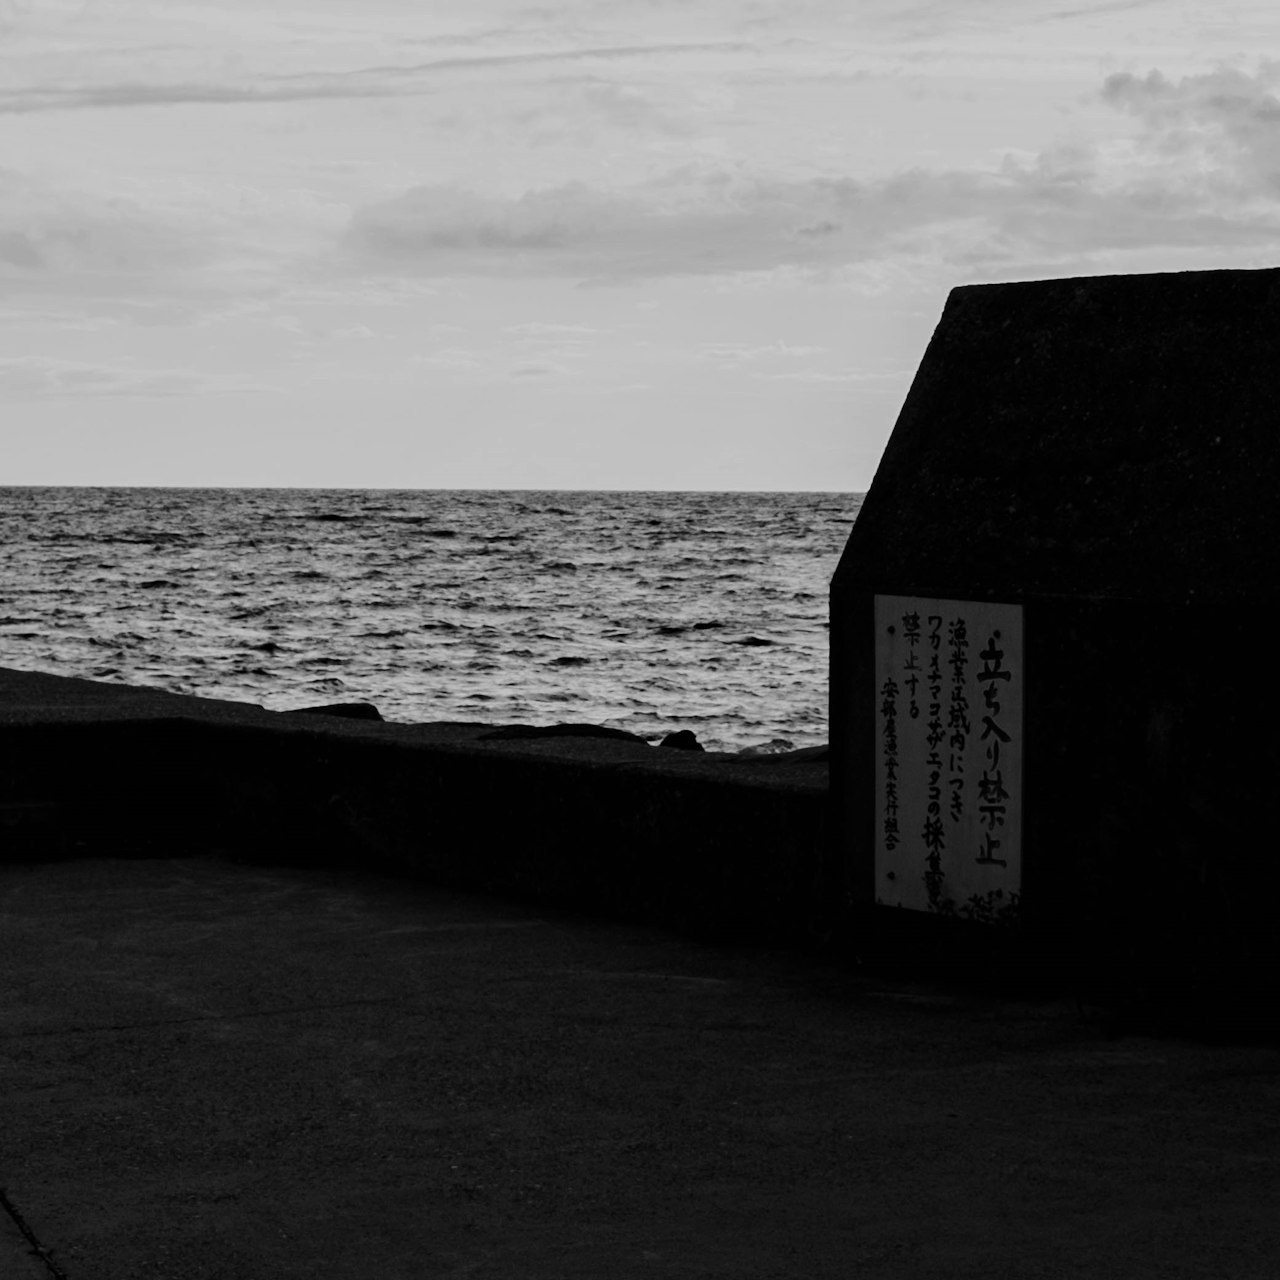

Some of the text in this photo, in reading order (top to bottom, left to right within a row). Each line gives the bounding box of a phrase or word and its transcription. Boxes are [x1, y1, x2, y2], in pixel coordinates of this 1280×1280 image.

[902, 611, 922, 720] 禁止する
[976, 637, 1011, 868] 立ち入り禁止
